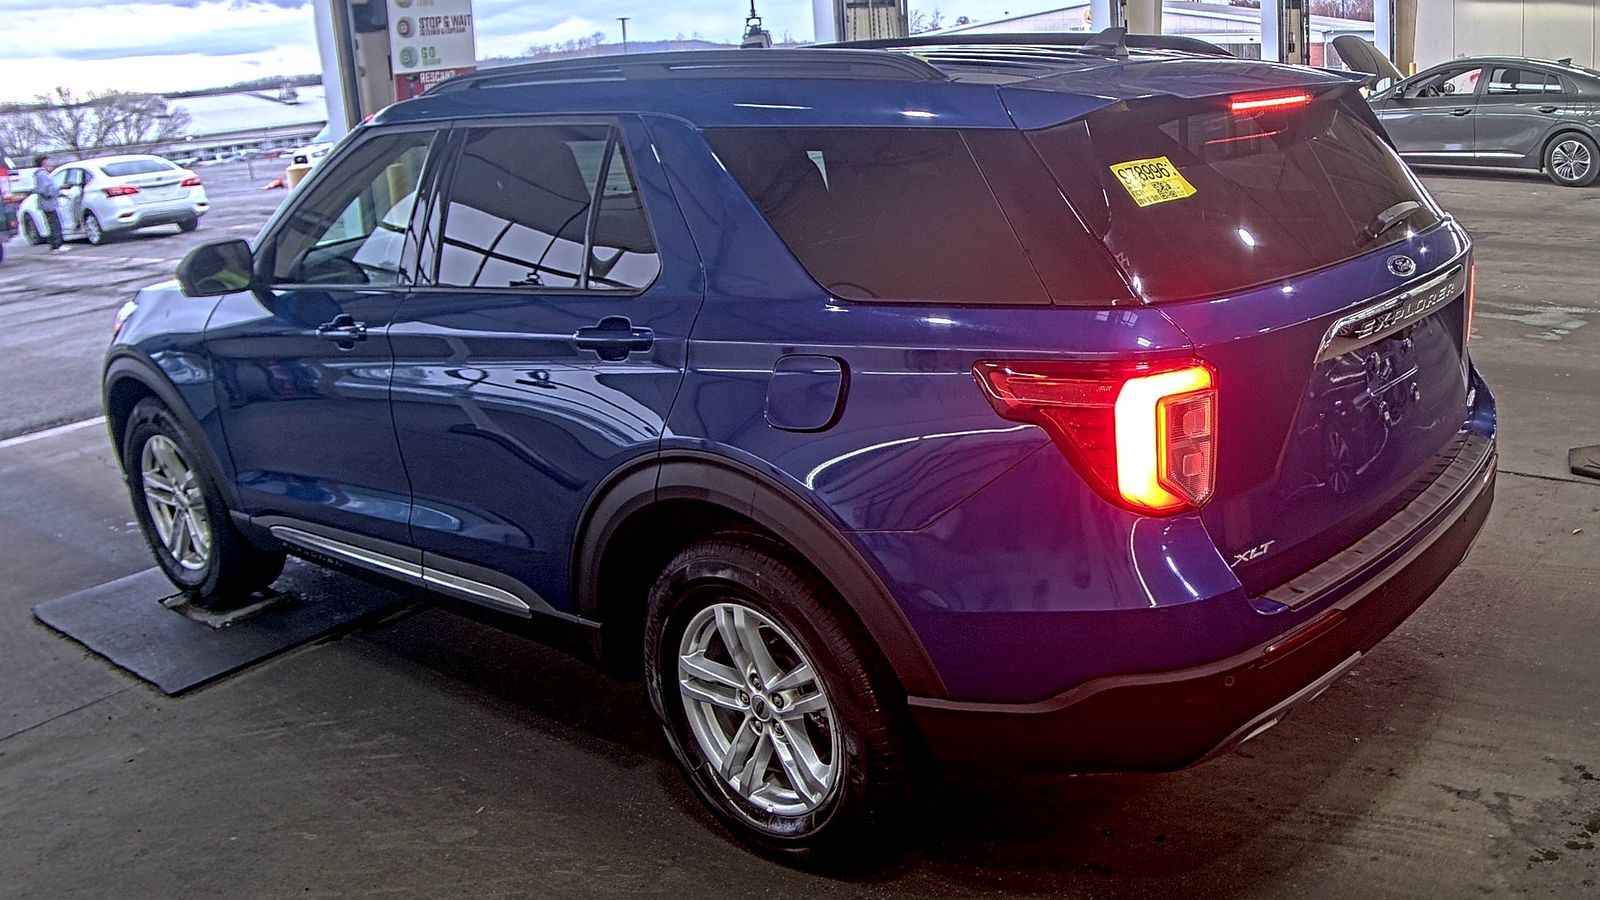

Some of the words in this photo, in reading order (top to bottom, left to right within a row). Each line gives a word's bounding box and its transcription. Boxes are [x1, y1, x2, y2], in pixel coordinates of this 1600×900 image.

[419, 16, 441, 29] STOP
[443, 15, 449, 27] &
[450, 15, 471, 26] WAIT
[421, 46, 436, 58] GO
[1355, 283, 1455, 339] EXPLORER
[1231, 540, 1275, 567] XLT
